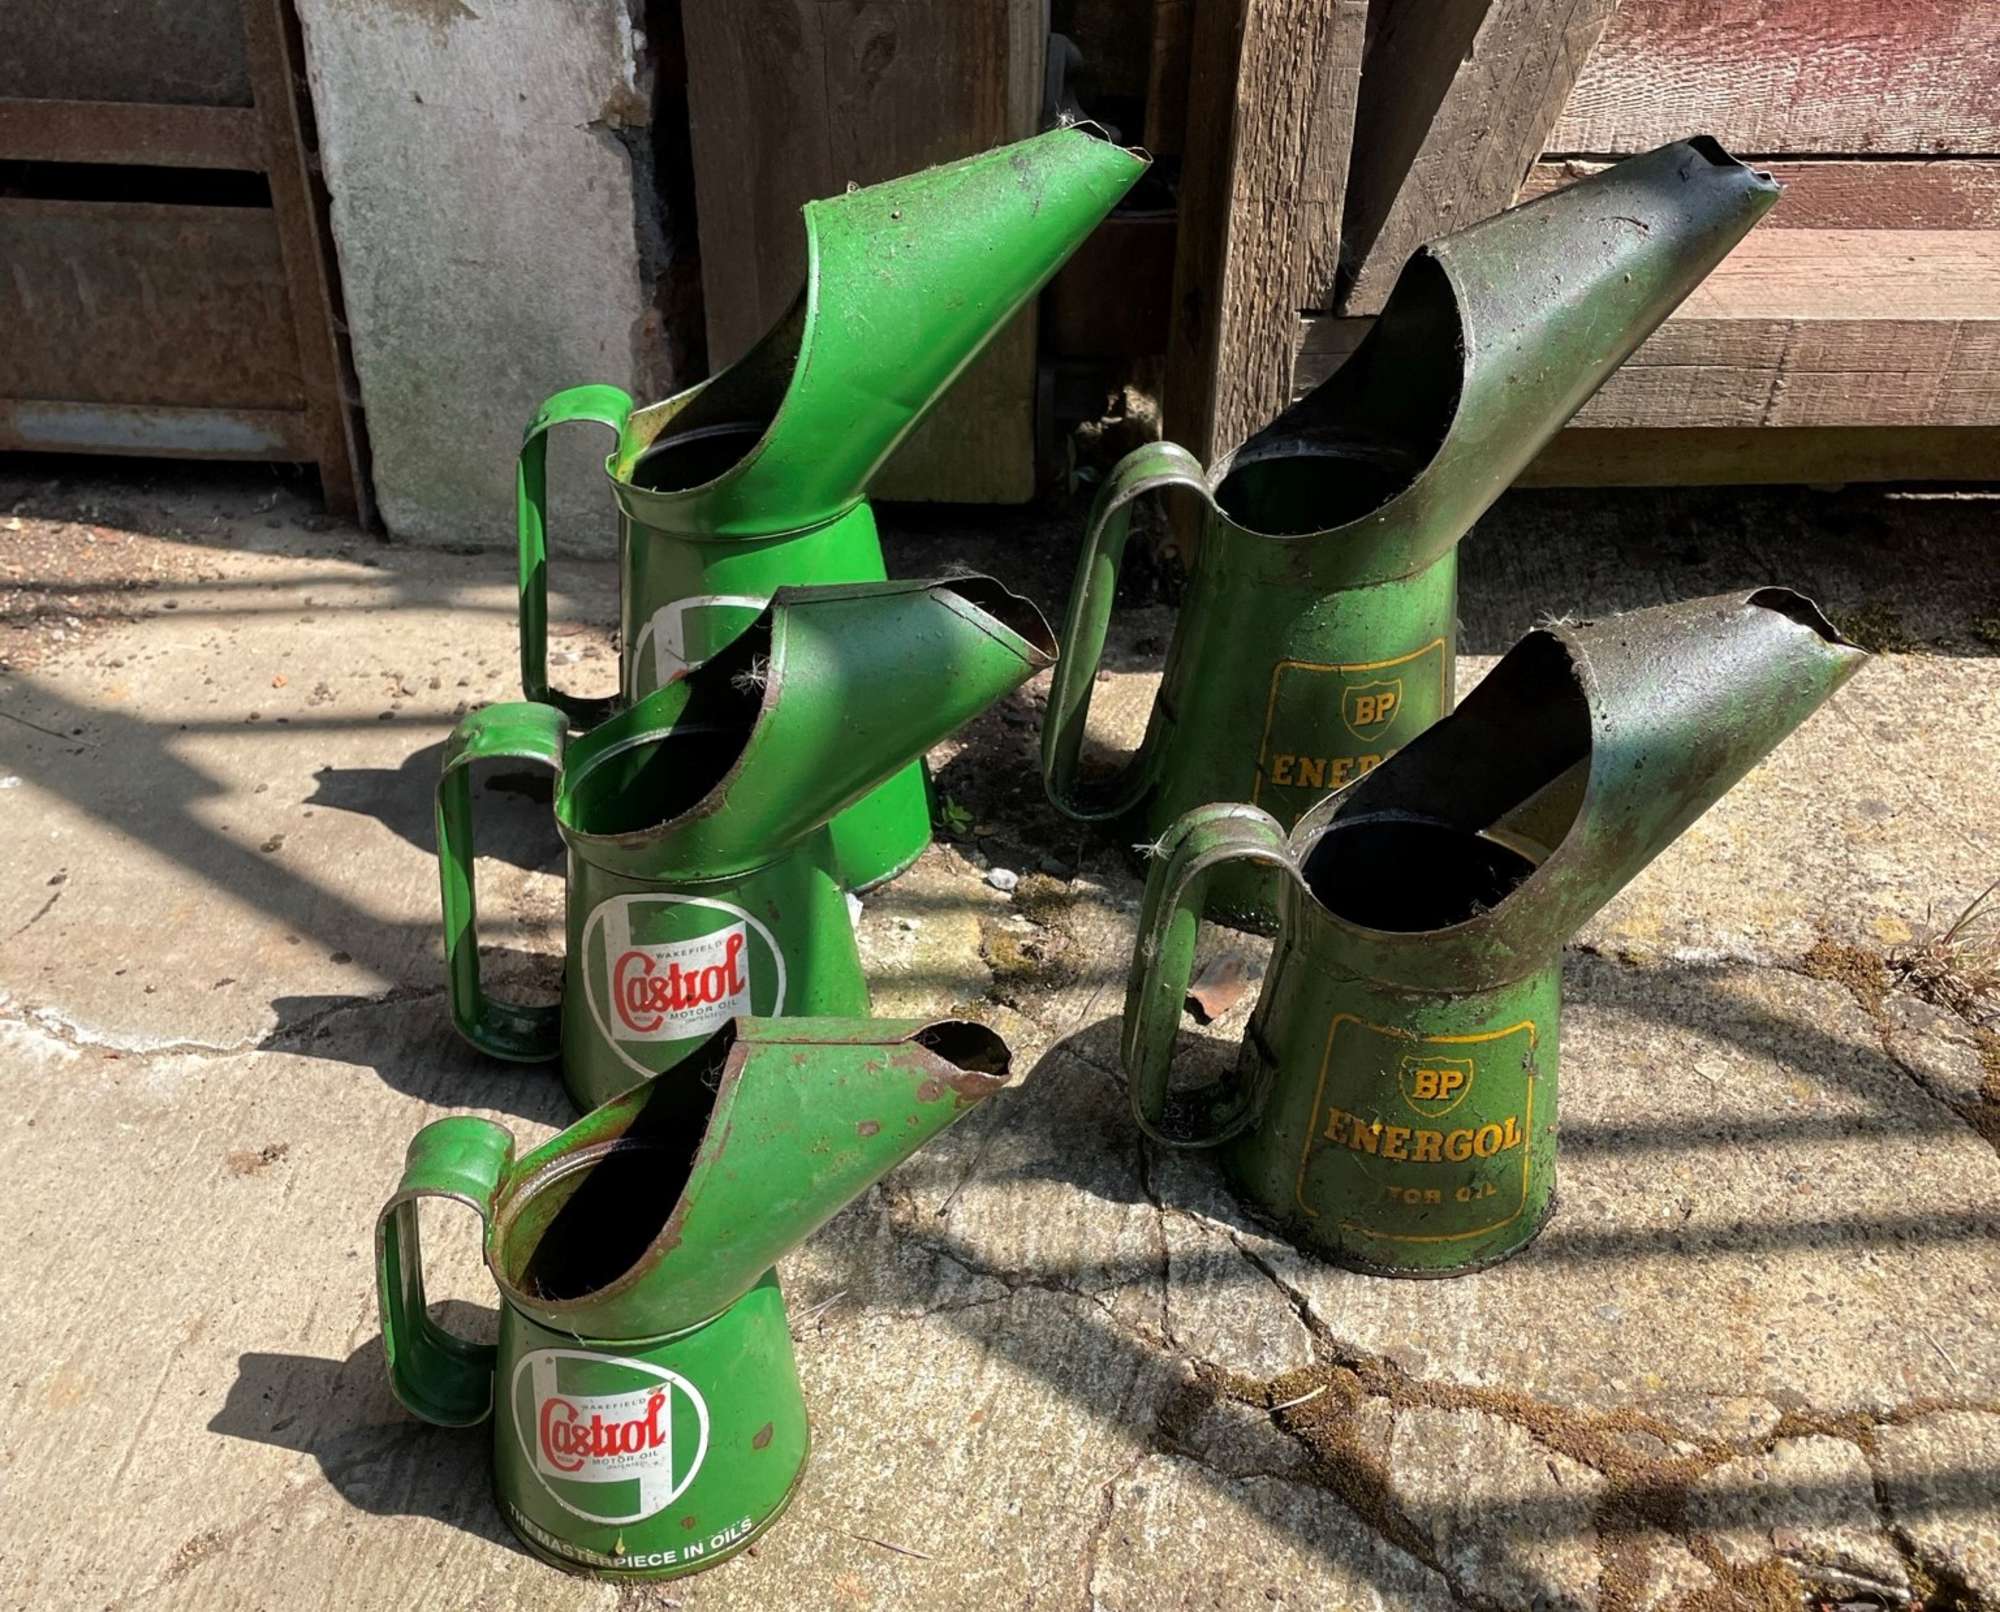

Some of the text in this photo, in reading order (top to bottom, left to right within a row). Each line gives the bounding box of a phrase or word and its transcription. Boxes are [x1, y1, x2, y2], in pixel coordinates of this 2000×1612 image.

[1354, 691, 1396, 726] BP
[656, 940, 722, 960] WAKEFIELD
[613, 932, 746, 1033] Castrol
[669, 1005, 714, 1021] MOTOR
[717, 999, 738, 1011] OIL
[1412, 1069, 1464, 1100] BP
[1323, 1106, 1522, 1163] ENERGOL
[540, 1393, 667, 1472] Castrol
[591, 1455, 635, 1466] MOTOR
[639, 1449, 658, 1461] OIL
[508, 1501, 753, 1569] THE MASTERPIECE IN OILS
